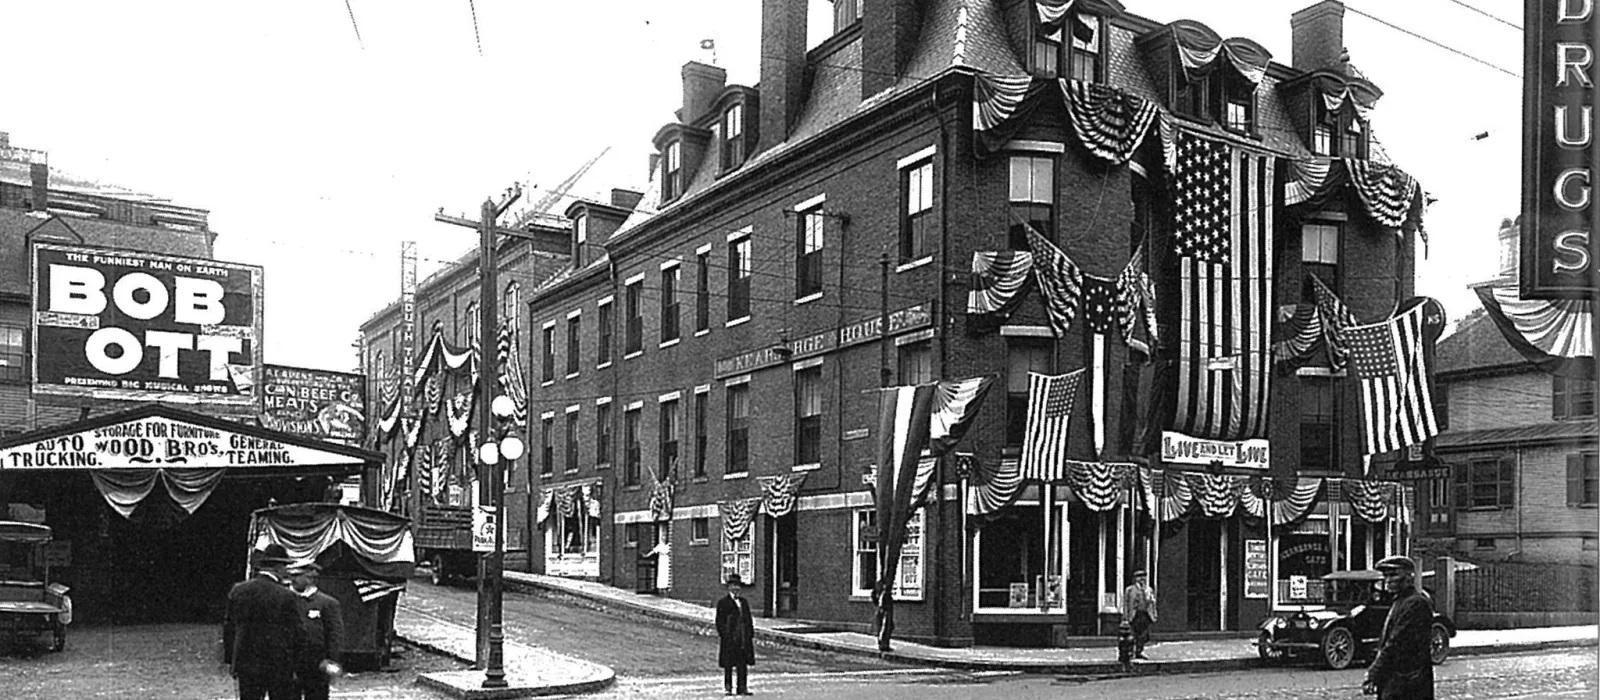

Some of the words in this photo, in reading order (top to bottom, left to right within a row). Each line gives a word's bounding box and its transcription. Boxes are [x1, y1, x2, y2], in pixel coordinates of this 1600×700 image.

[66, 252, 89, 263] THE
[93, 255, 145, 267] FUNNIEST
[150, 260, 172, 271] MAN
[176, 264, 191, 273] ON
[196, 266, 229, 277] EARTH
[49, 263, 226, 325] BOB
[85, 326, 243, 381] OTT
[64, 377, 118, 388] PRESENTING
[122, 380, 140, 389] BIG
[144, 381, 189, 392] MUSICAL
[194, 384, 228, 394] SHOWS
[300, 387, 337, 401] BEEF
[264, 396, 319, 413] MEATS
[94, 422, 143, 438] STORAGE
[146, 422, 167, 438] FOR
[171, 423, 221, 439] FURNITURE
[35, 435, 84, 451] AUTO
[95, 438, 154, 457] WOOD
[230, 434, 285, 450] GENERAL
[1163, 436, 1200, 459] LIVE
[1200, 443, 1217, 455] AND
[1218, 444, 1235, 456] LET
[1235, 443, 1267, 464] LIVE
[8, 451, 103, 467] TRUCKING.
[225, 450, 295, 465] TEAMING.
